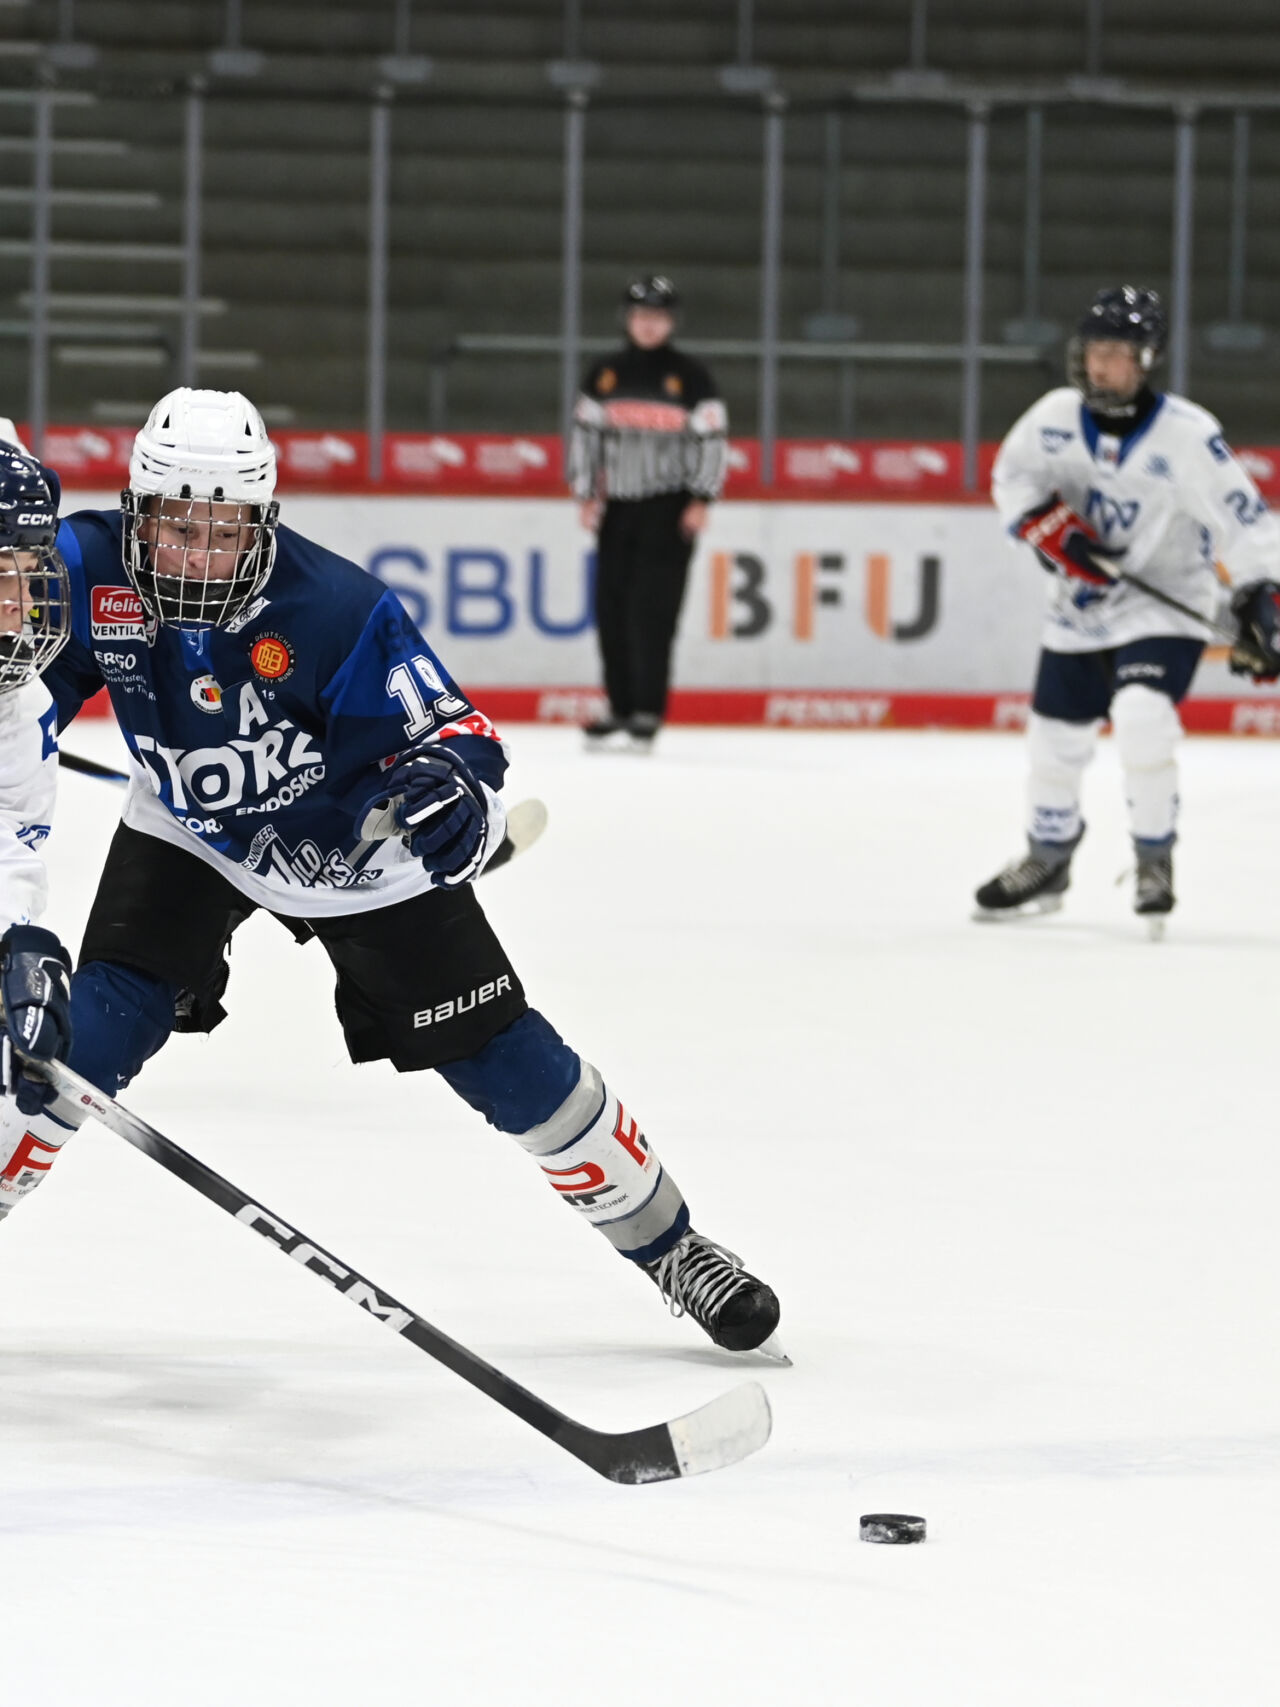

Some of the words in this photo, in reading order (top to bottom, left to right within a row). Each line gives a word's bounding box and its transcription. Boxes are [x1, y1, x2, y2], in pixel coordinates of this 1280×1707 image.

[17, 513, 53, 526] CCM
[99, 597, 142, 613] Helio
[709, 550, 941, 643] BFU
[94, 650, 137, 670] ERGO
[386, 655, 468, 741] 19
[235, 765, 326, 816] ENDOSKO
[242, 825, 275, 870] ENNINGER
[23, 1006, 36, 1041] CCM
[235, 1204, 415, 1333] CCM
